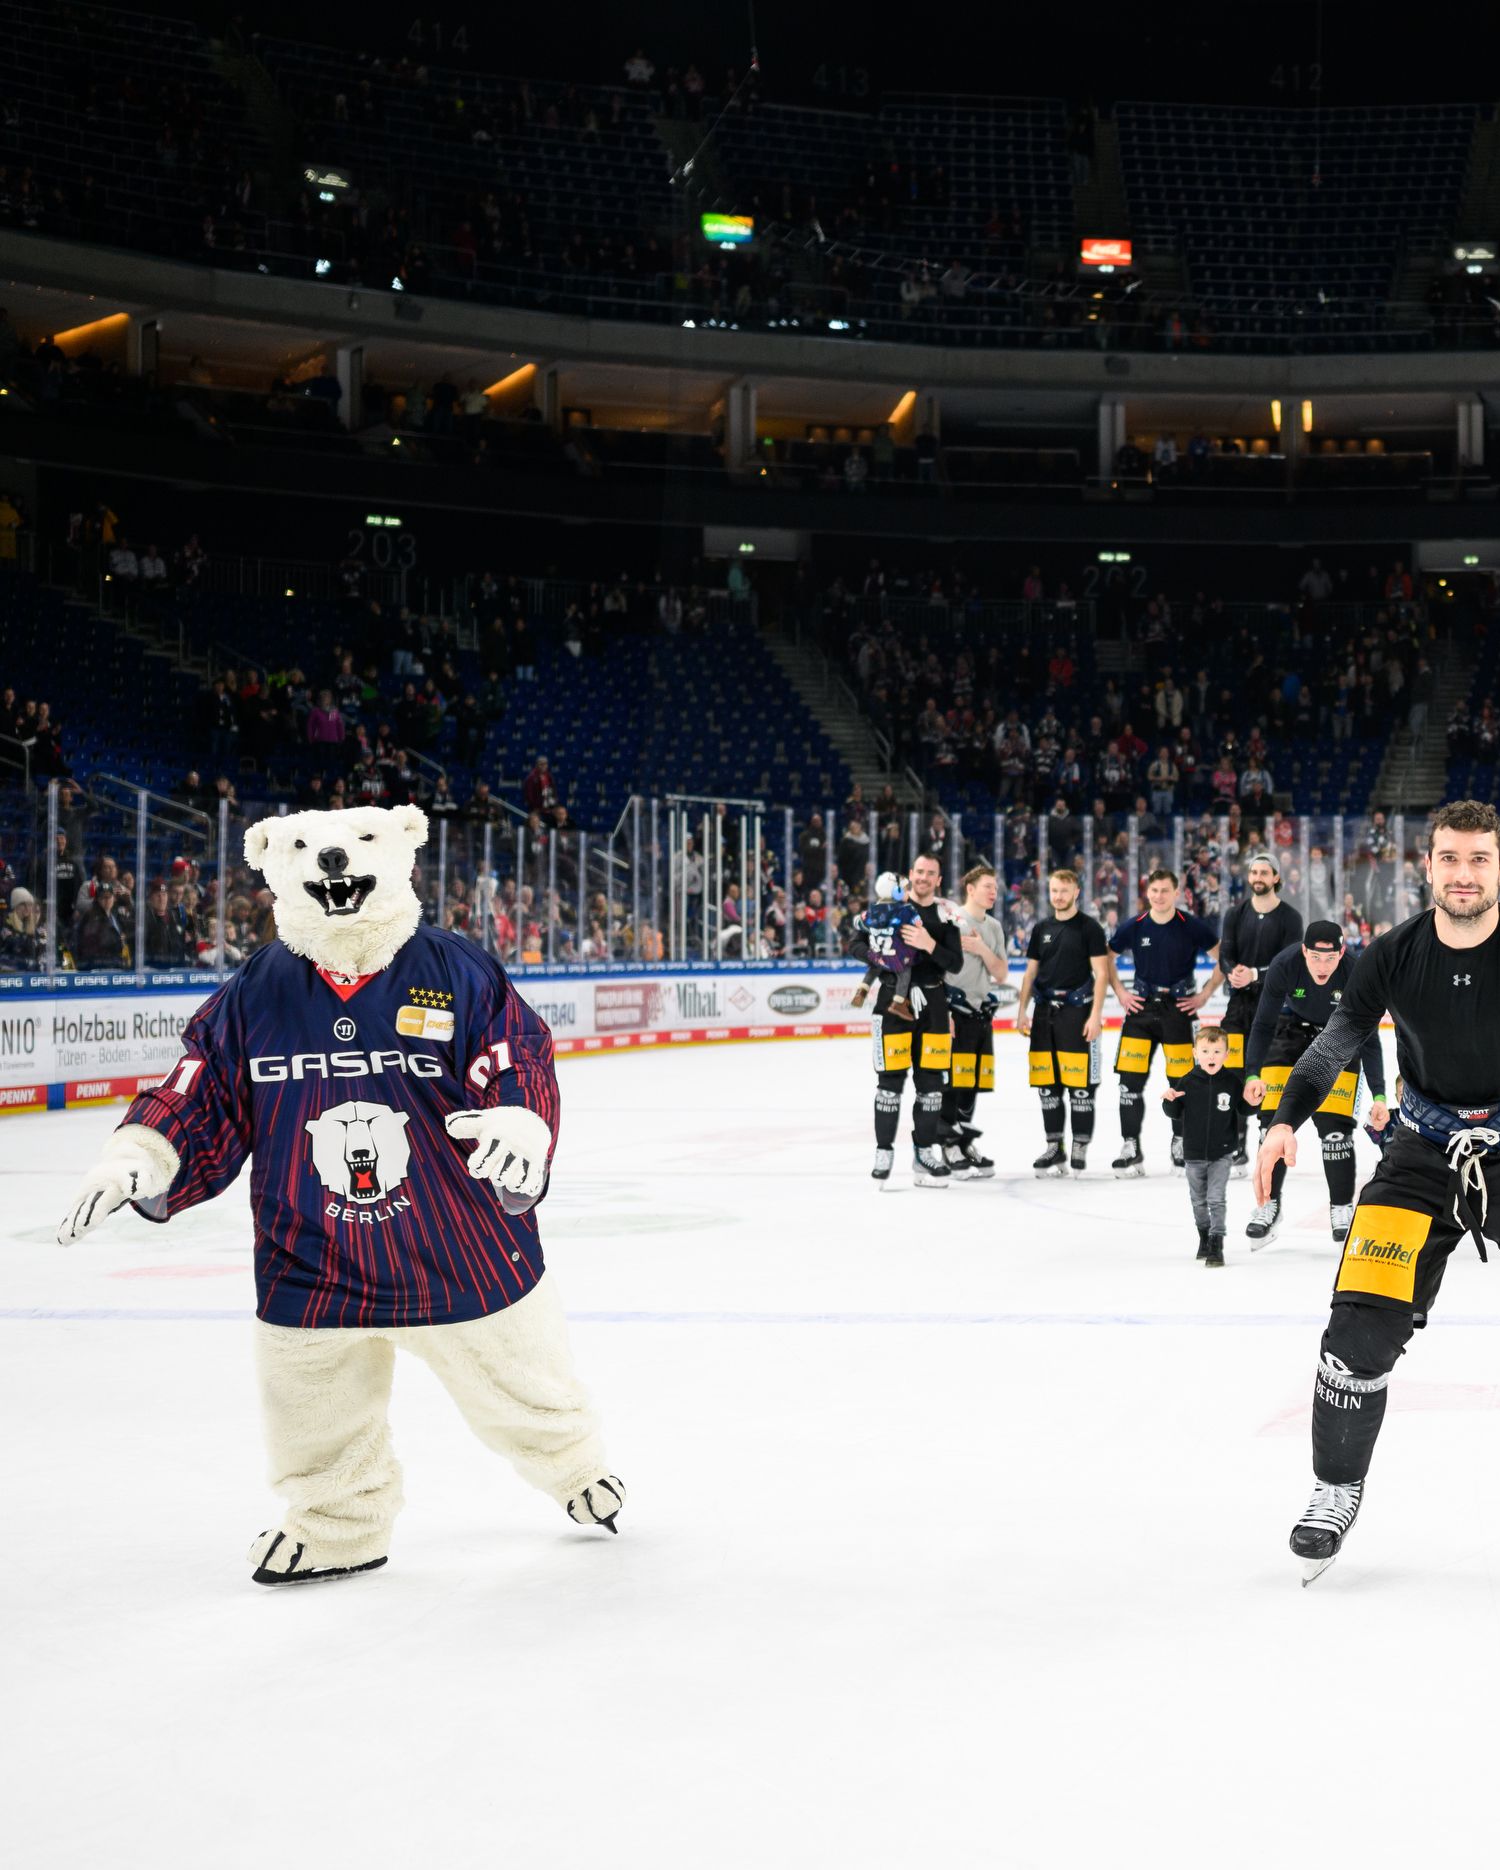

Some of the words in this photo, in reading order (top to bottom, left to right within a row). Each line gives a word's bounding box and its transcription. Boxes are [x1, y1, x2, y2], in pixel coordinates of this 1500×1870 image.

[407, 18, 472, 54] 414
[347, 528, 417, 570] 203
[74, 976, 108, 986] GASAG
[152, 974, 185, 984] GASAG
[53, 1013, 126, 1044] Holzbau
[57, 1048, 87, 1067] Türen
[250, 1051, 443, 1083] GASAG
[1329, 1087, 1352, 1099] nittel
[1322, 1151, 1351, 1161] BERLIN
[325, 1195, 412, 1225] BERLIN
[1360, 1239, 1416, 1265] Knittel
[1316, 1379, 1362, 1410] BERLIN
